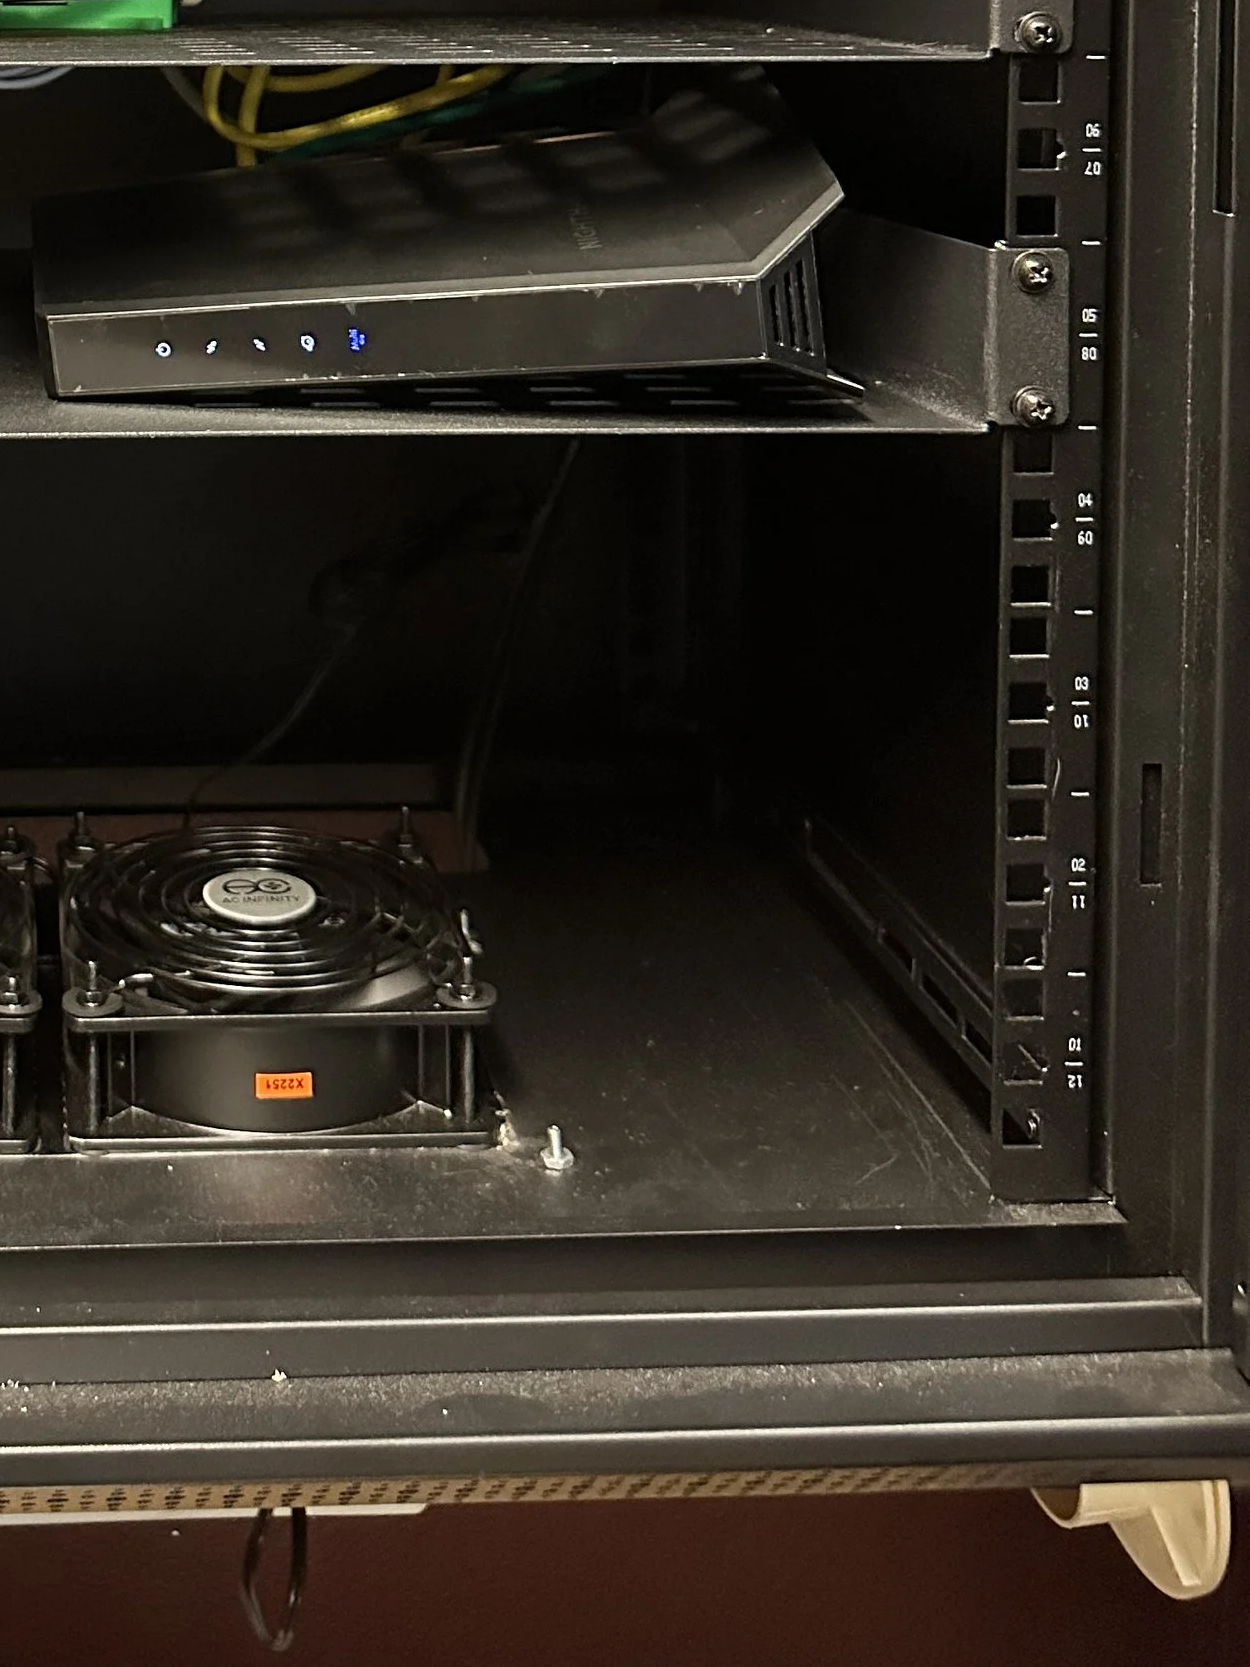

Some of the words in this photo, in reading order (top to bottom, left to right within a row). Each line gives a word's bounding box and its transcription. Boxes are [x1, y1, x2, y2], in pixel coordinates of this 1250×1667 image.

[1085, 123, 1101, 138] 06
[1081, 308, 1098, 323] 05
[1077, 492, 1093, 508] 04
[1074, 676, 1089, 691] 03
[1071, 857, 1087, 872] 02
[222, 896, 240, 904] AC
[243, 894, 300, 905] INFINITY
[1068, 1037, 1082, 1052] 01
[266, 1077, 305, 1090] X2251
